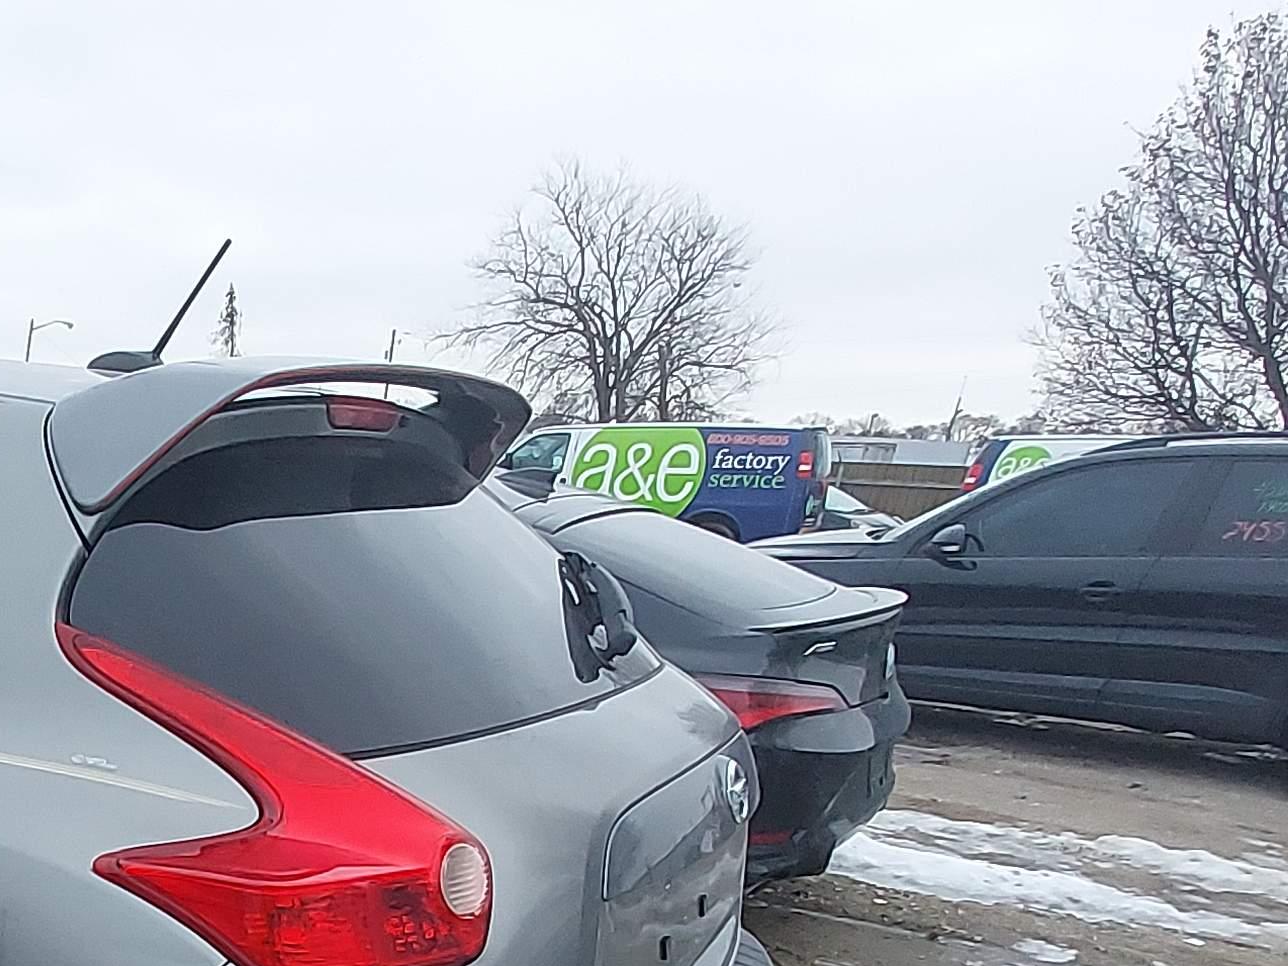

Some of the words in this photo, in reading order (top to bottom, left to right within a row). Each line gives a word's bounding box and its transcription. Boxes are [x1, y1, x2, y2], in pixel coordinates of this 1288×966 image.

[577, 443, 700, 503] a&e
[711, 448, 791, 475] factory
[707, 470, 785, 489] service
